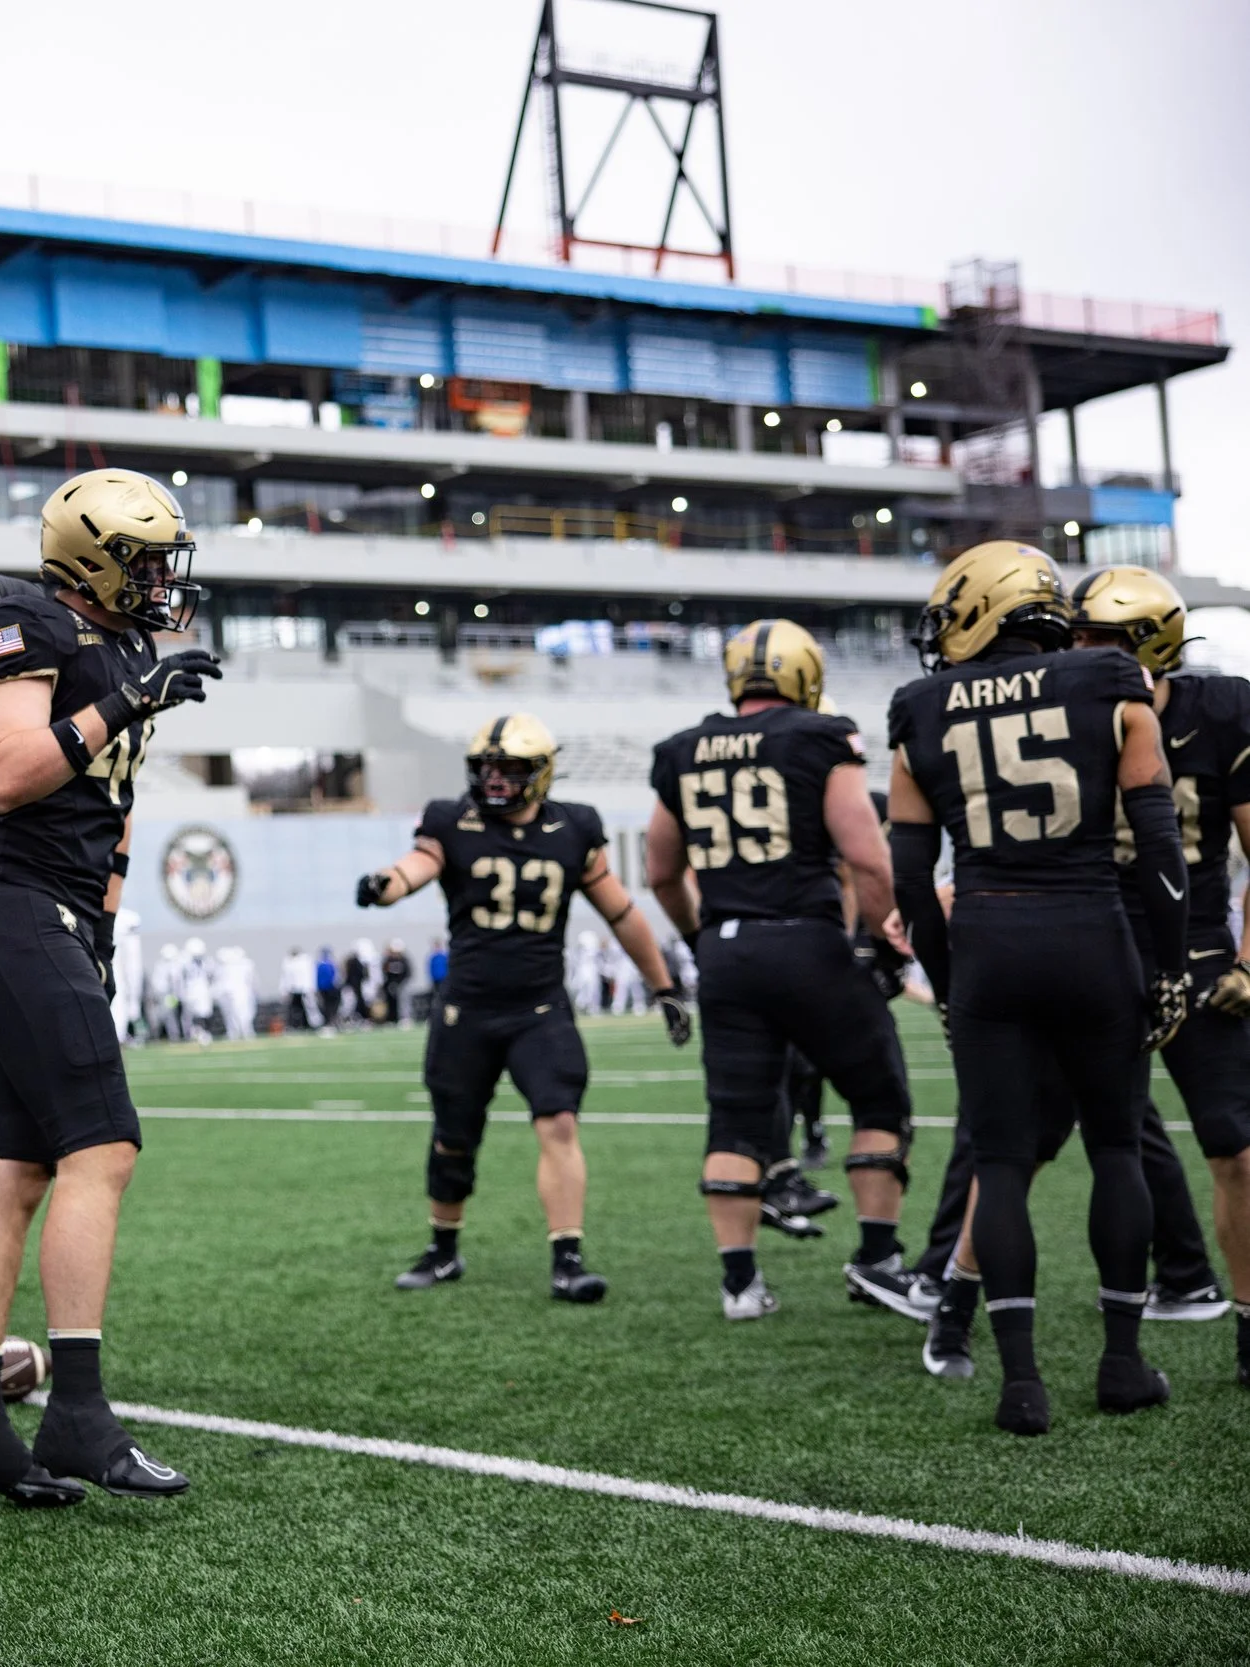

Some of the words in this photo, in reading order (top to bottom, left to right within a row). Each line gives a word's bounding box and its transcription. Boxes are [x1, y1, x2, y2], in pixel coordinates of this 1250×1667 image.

[946, 668, 1047, 711] ARMY
[694, 732, 763, 764] ARMY
[942, 706, 1081, 849] 15
[679, 766, 792, 871] 59
[471, 856, 564, 933] 33
